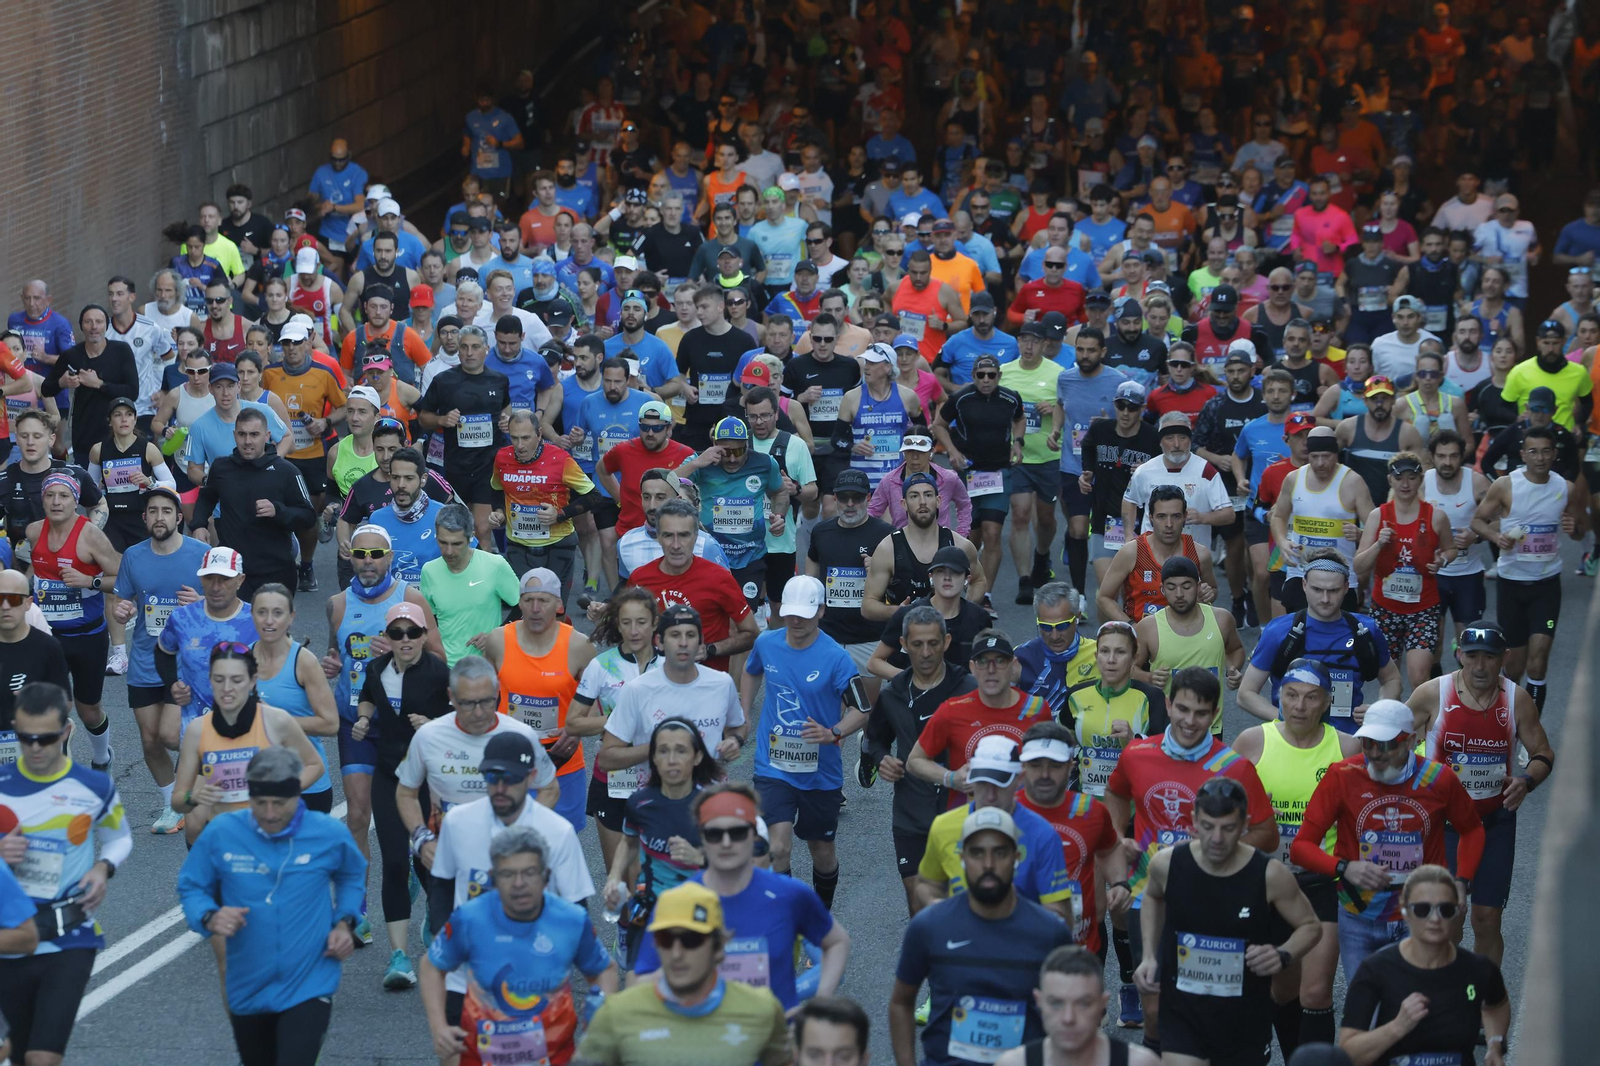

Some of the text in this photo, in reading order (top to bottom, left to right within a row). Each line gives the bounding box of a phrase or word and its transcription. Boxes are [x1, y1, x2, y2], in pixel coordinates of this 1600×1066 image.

[706, 390, 724, 398] NOAH
[460, 431, 490, 441] DAVISICO
[503, 473, 548, 484] BUDAPEST
[974, 480, 996, 490] NACER
[713, 517, 754, 526] CHRISTOPHE
[518, 522, 541, 532] BMMH
[1310, 540, 1335, 548] ZURICH
[1522, 544, 1532, 553] EL
[668, 590, 683, 599] TCS
[829, 589, 850, 599] PACO
[1390, 584, 1414, 595] DIANA
[56, 602, 82, 612] MIGUEL
[525, 697, 553, 706] ZURICH
[523, 710, 542, 719] 10963
[784, 741, 803, 750] 10537
[1467, 738, 1509, 748] ALTACASA
[220, 750, 254, 762] ZURICH
[769, 748, 818, 762] PEPINATOR
[1471, 755, 1501, 764] ZURICH
[440, 765, 459, 774] C.A.
[1469, 769, 1490, 778] 10947
[608, 781, 625, 790] SARA
[1381, 833, 1416, 844] ZURICH
[28, 839, 60, 851] URICH
[1199, 938, 1237, 951] ZURICH
[1198, 956, 1222, 967] 10734
[1178, 967, 1242, 985] CLAUDIA Y LEO
[978, 1001, 1019, 1014] ZURICH
[496, 1020, 535, 1034] ZURICH
[970, 1031, 1003, 1047] LEPS
[1414, 1056, 1454, 1066] ZURICH
